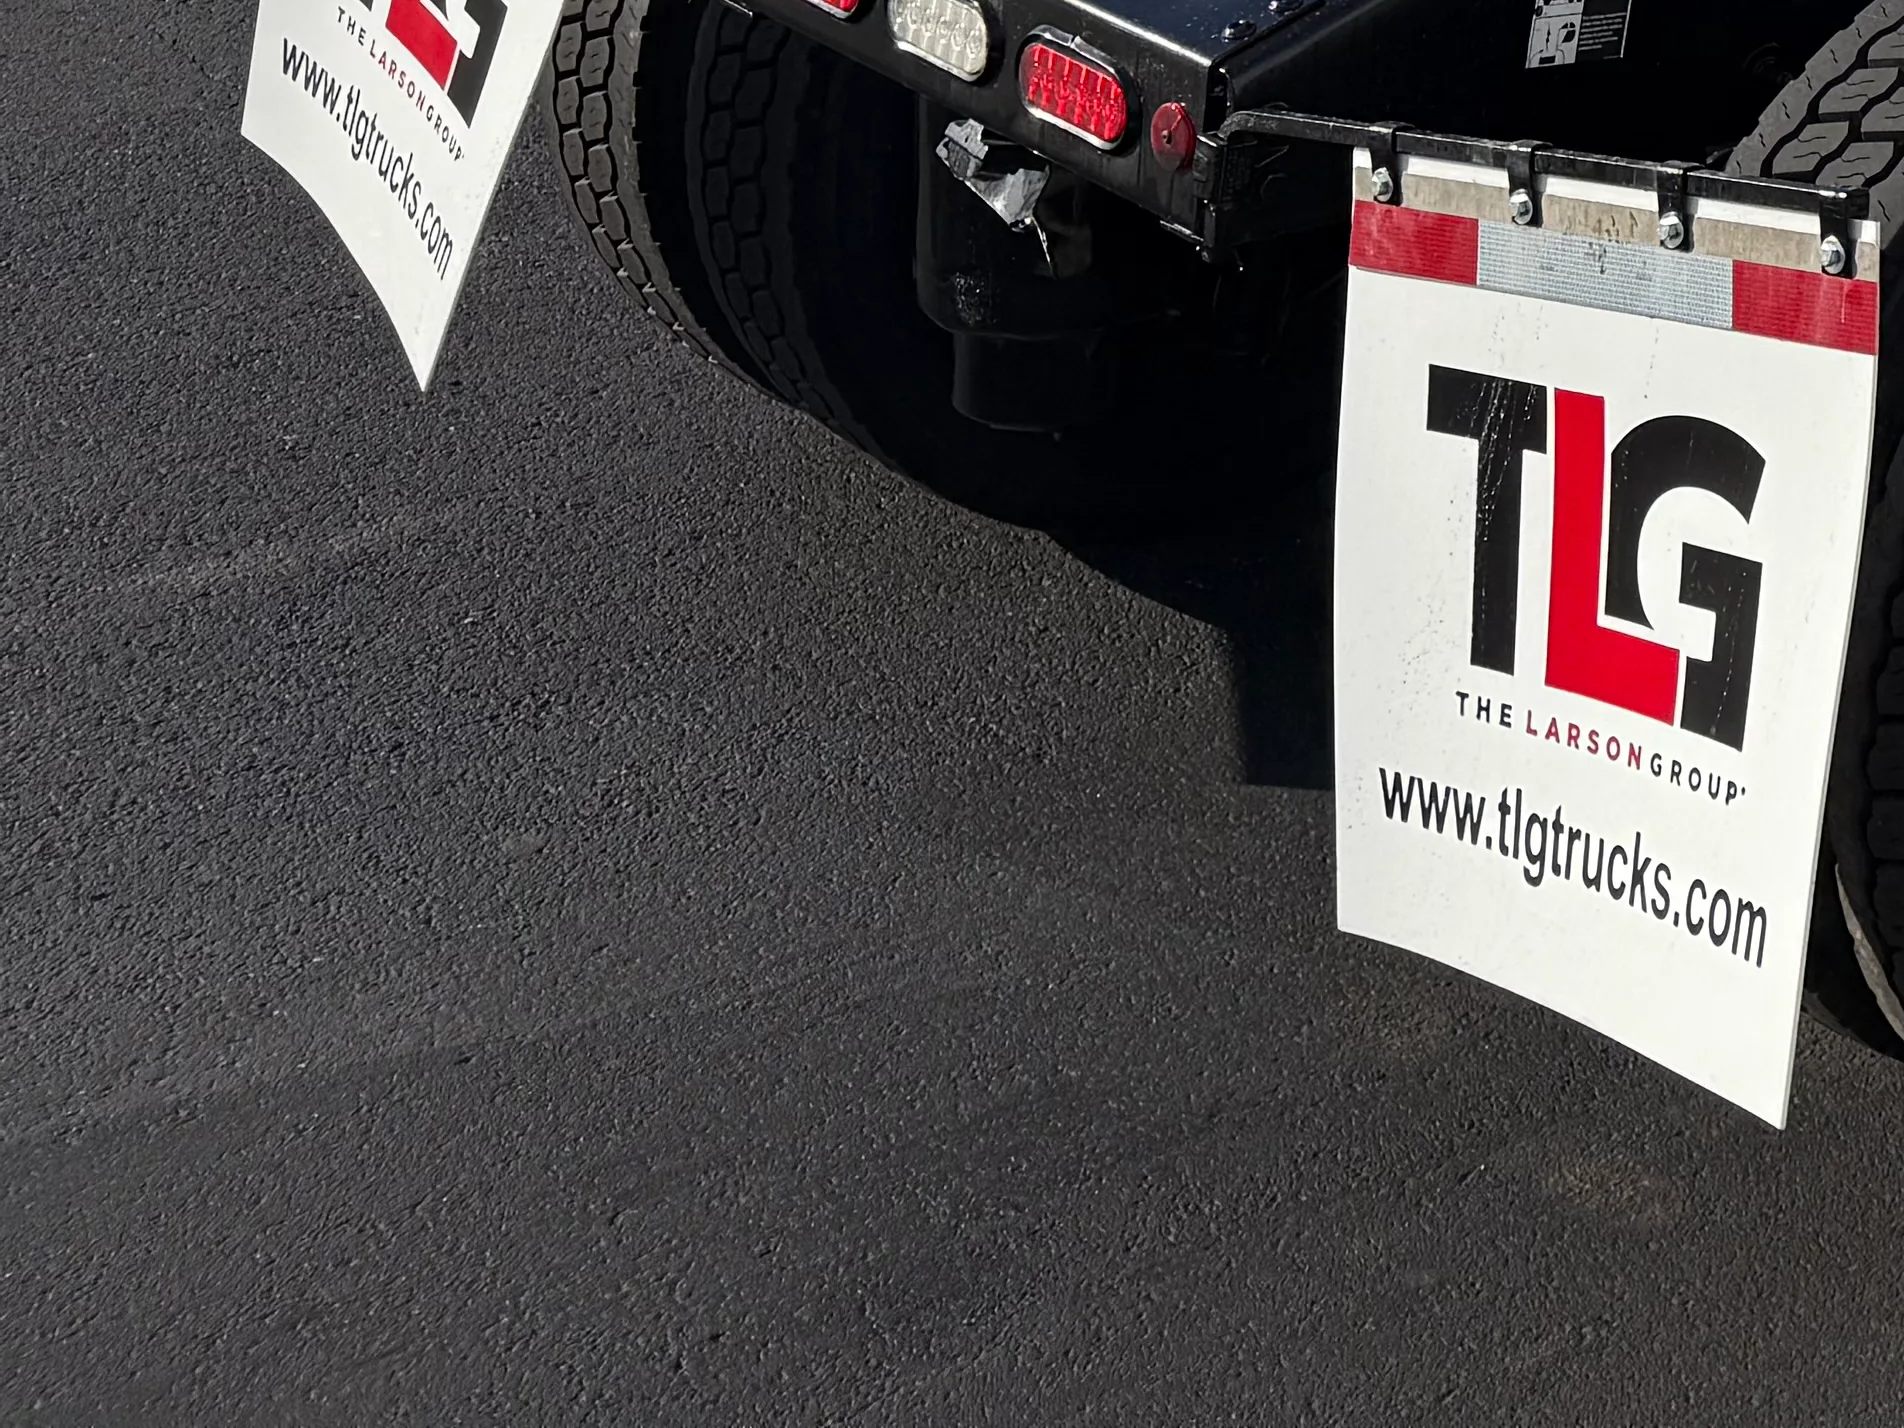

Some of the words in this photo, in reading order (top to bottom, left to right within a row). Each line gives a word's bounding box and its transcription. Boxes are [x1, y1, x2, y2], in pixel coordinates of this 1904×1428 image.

[282, 37, 454, 281] www.tlgtrucks.com
[337, 5, 367, 46] THE
[369, 39, 426, 112] LARSON
[426, 105, 462, 162] GROUP
[1426, 363, 1766, 752] TLG
[1455, 690, 1513, 729] THE
[1525, 709, 1643, 771] LARSON
[1650, 752, 1740, 806] GROUP
[1377, 766, 1768, 969] www.tlgtrucks.com
